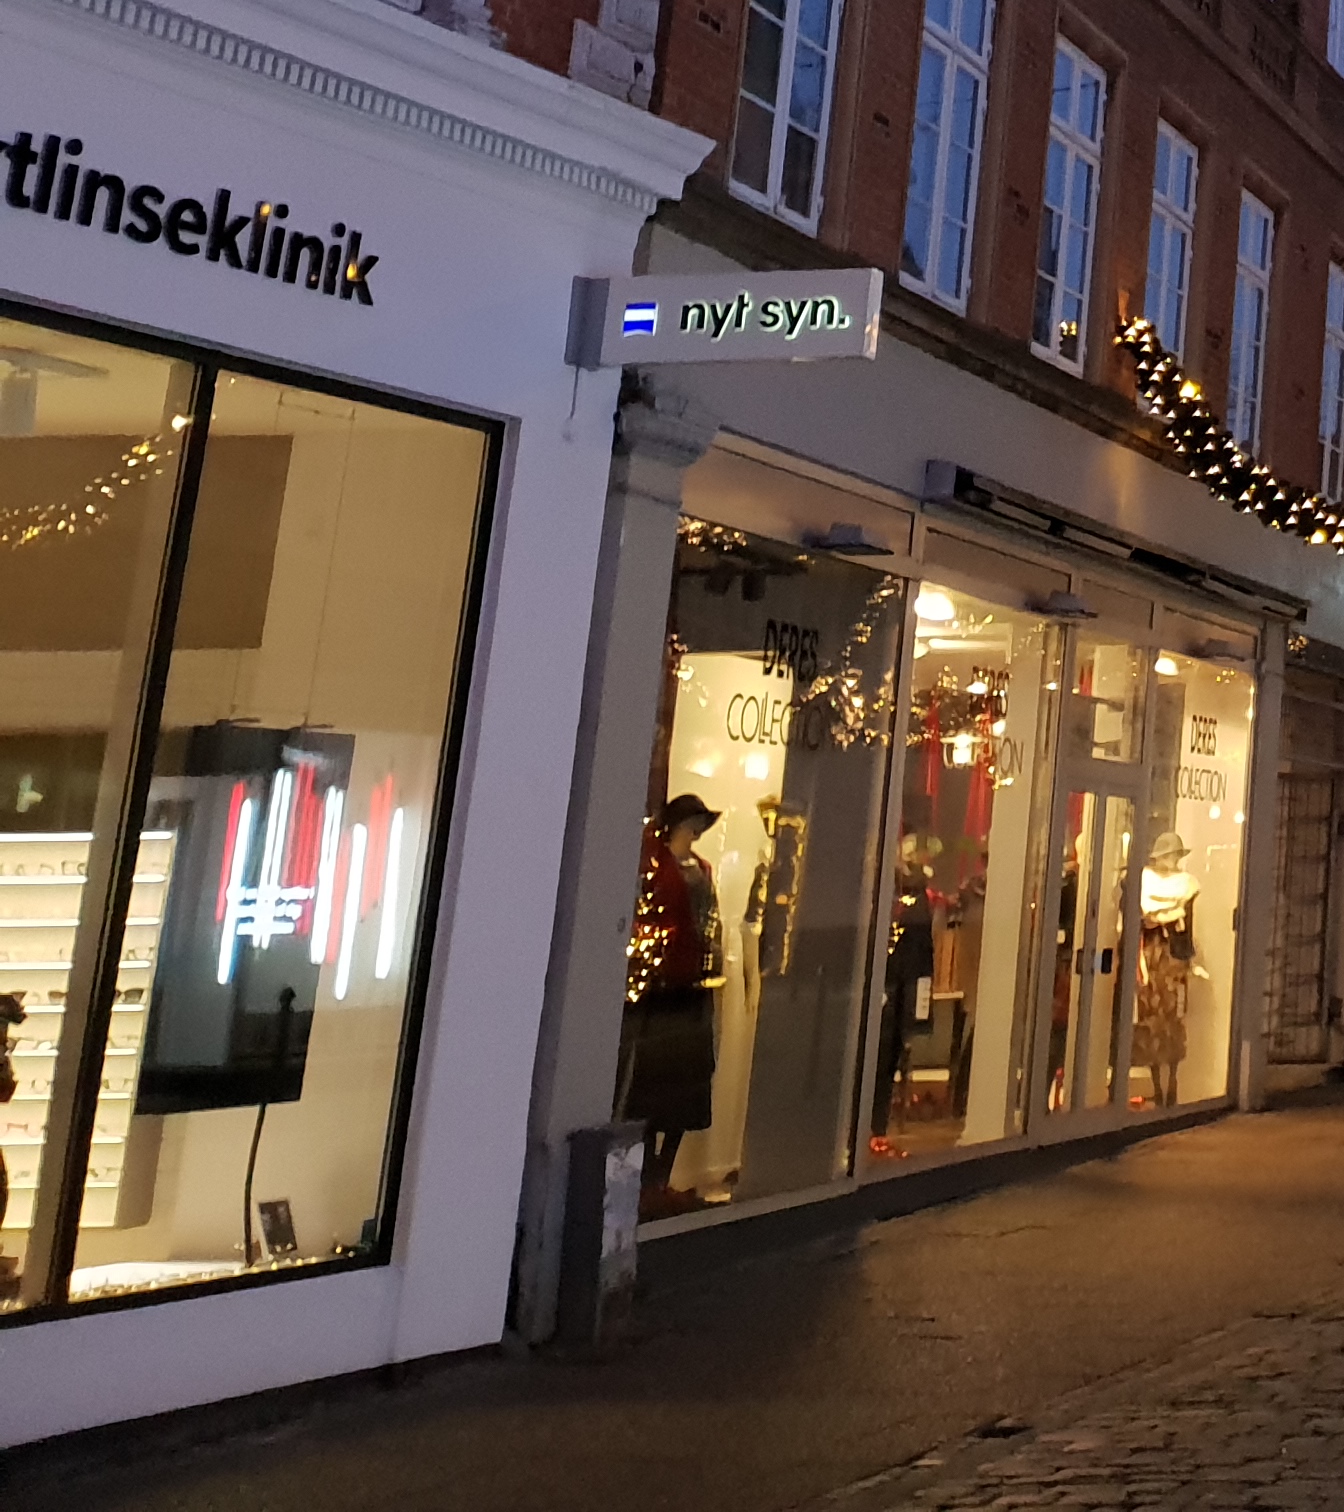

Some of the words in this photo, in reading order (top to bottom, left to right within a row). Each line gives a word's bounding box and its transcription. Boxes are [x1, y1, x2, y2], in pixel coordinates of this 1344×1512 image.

[0, 131, 379, 306] tlinseklinik
[680, 289, 751, 342] nyt
[759, 296, 851, 341] syn.
[762, 618, 818, 682] DERES
